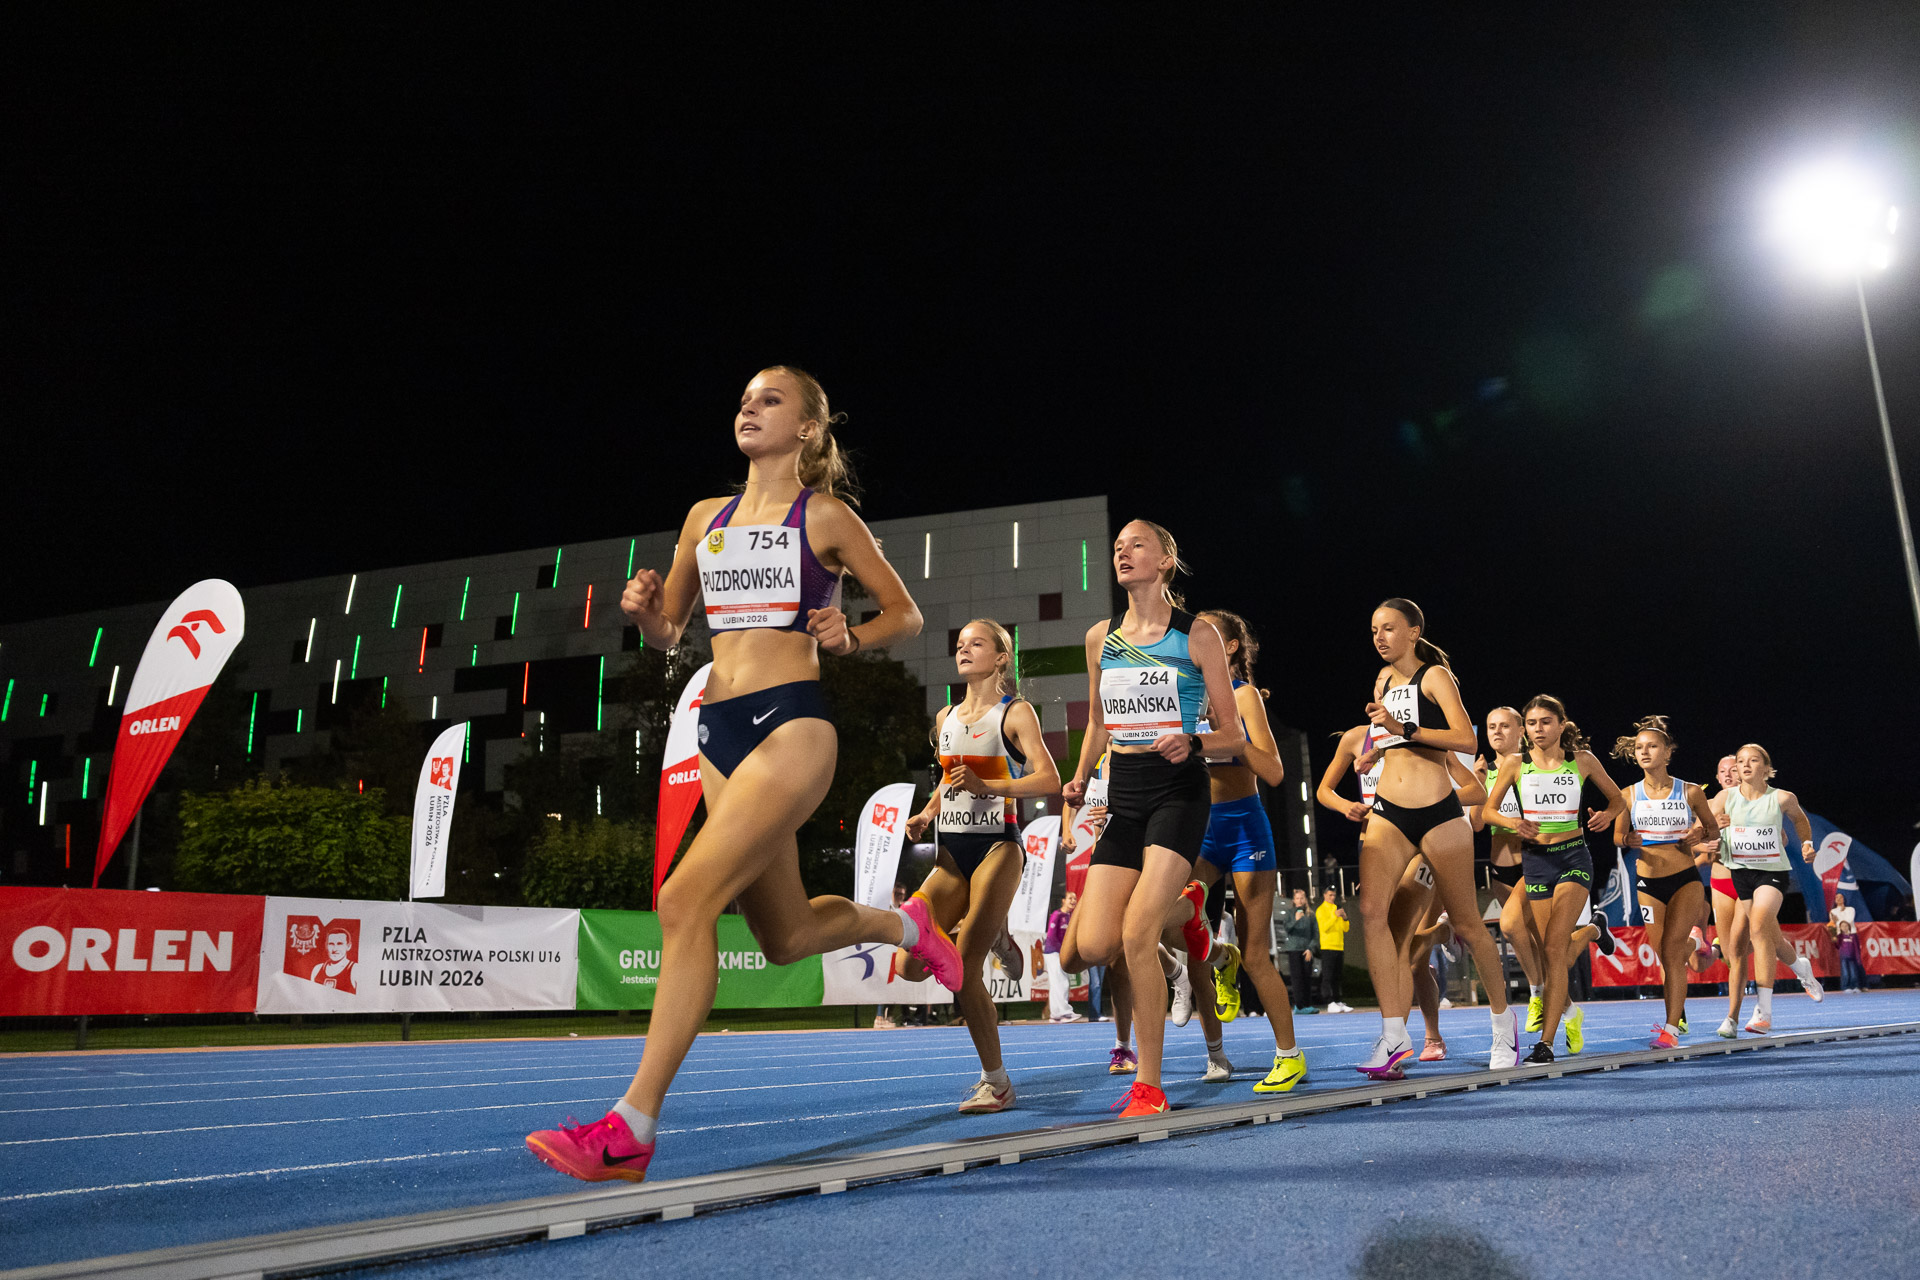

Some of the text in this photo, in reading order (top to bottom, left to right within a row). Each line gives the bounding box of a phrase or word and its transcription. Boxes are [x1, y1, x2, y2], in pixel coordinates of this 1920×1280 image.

[748, 531, 789, 551] 754
[702, 566, 795, 592] PUZDROWSKA
[722, 614, 768, 625] LUBIN 2026
[1139, 670, 1169, 686] 264
[1391, 688, 1411, 701] 771
[1103, 693, 1178, 714] URBAŃSKA
[129, 715, 181, 736] ORLEN
[1553, 776, 1574, 786] 455
[442, 795, 450, 817] PZLA
[1534, 793, 1567, 805] LATO
[1661, 801, 1686, 810] 1210
[425, 795, 436, 847] LUBIN 2026
[941, 810, 1000, 826] KAROLAK
[1636, 815, 1686, 826] WRÓBLEWSKA
[1756, 827, 1774, 836] 969
[1546, 839, 1584, 853] NIKE PRO
[1733, 841, 1776, 850] WOLNIK
[1248, 850, 1267, 861] 4F
[382, 926, 427, 943] PZLA
[12, 925, 234, 972] ORLEN
[1865, 937, 1920, 957] ORLEN
[381, 948, 561, 963] MISTRZOSTWA POLSKI U16
[379, 969, 484, 986] LUBIN 2026
[620, 974, 659, 984] Jesteśm
